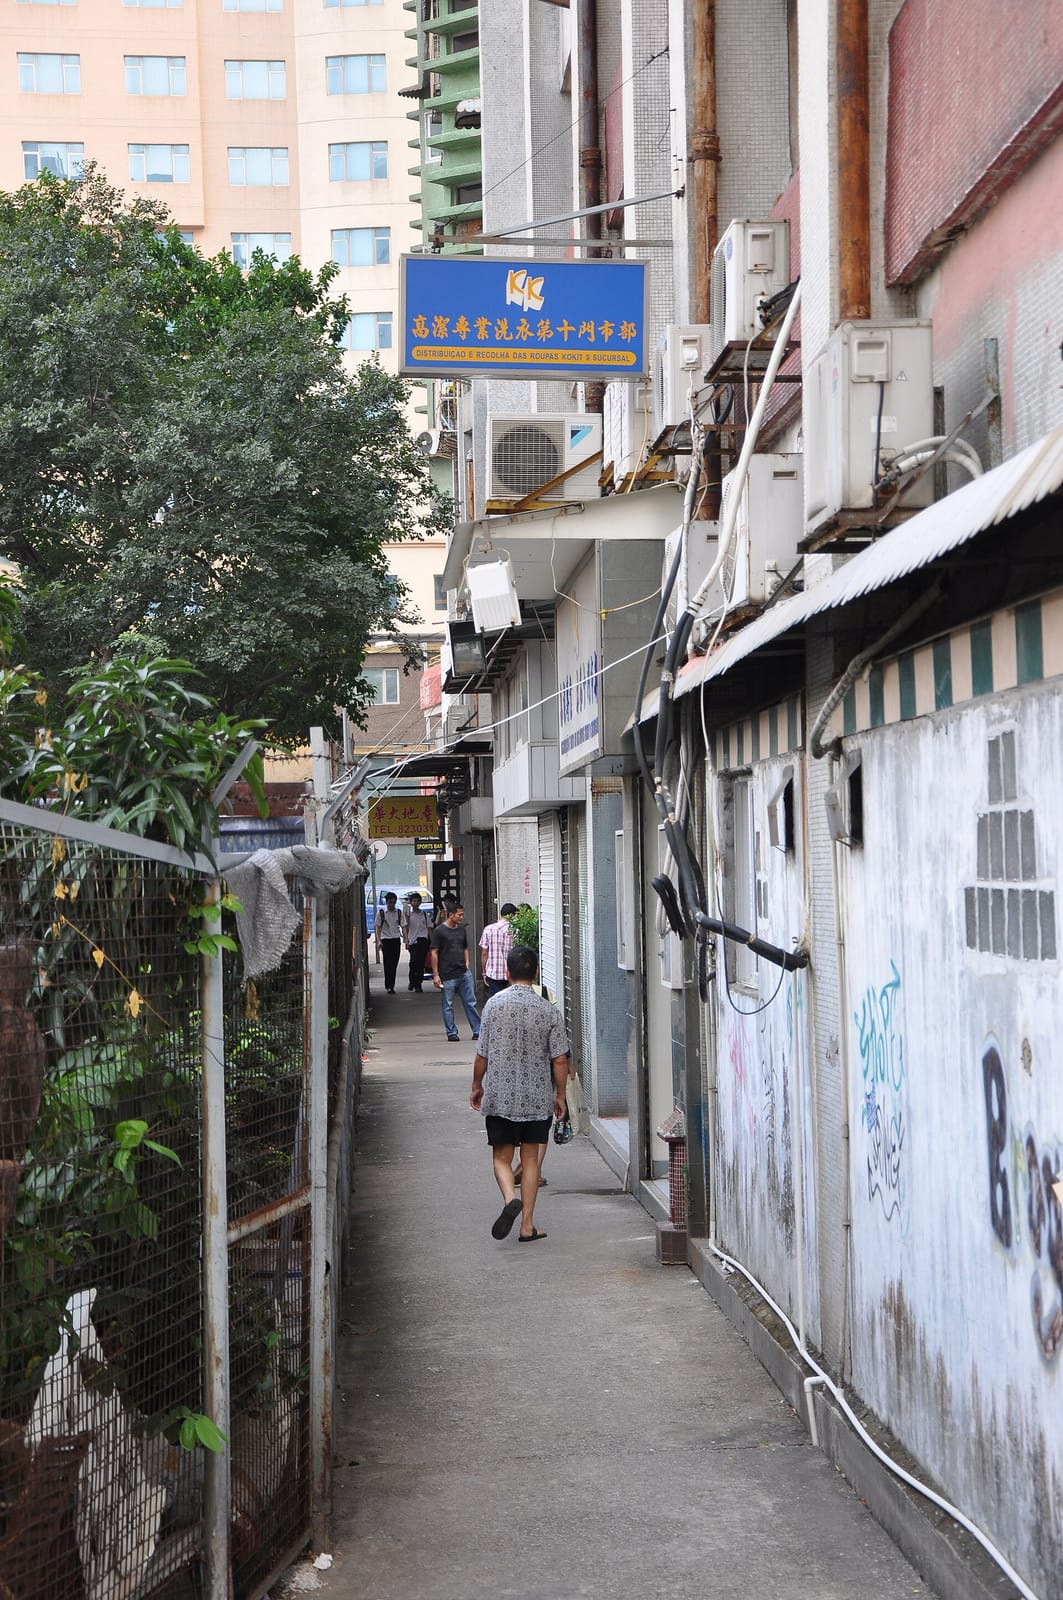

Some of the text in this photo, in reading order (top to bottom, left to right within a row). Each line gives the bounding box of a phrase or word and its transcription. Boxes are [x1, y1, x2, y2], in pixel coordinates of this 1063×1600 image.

[506, 269, 545, 312] KK
[476, 351, 509, 359] RECOLHA
[512, 351, 528, 360] DAS
[530, 352, 559, 360] ROUPAS
[592, 353, 630, 362] SUCURSAL
